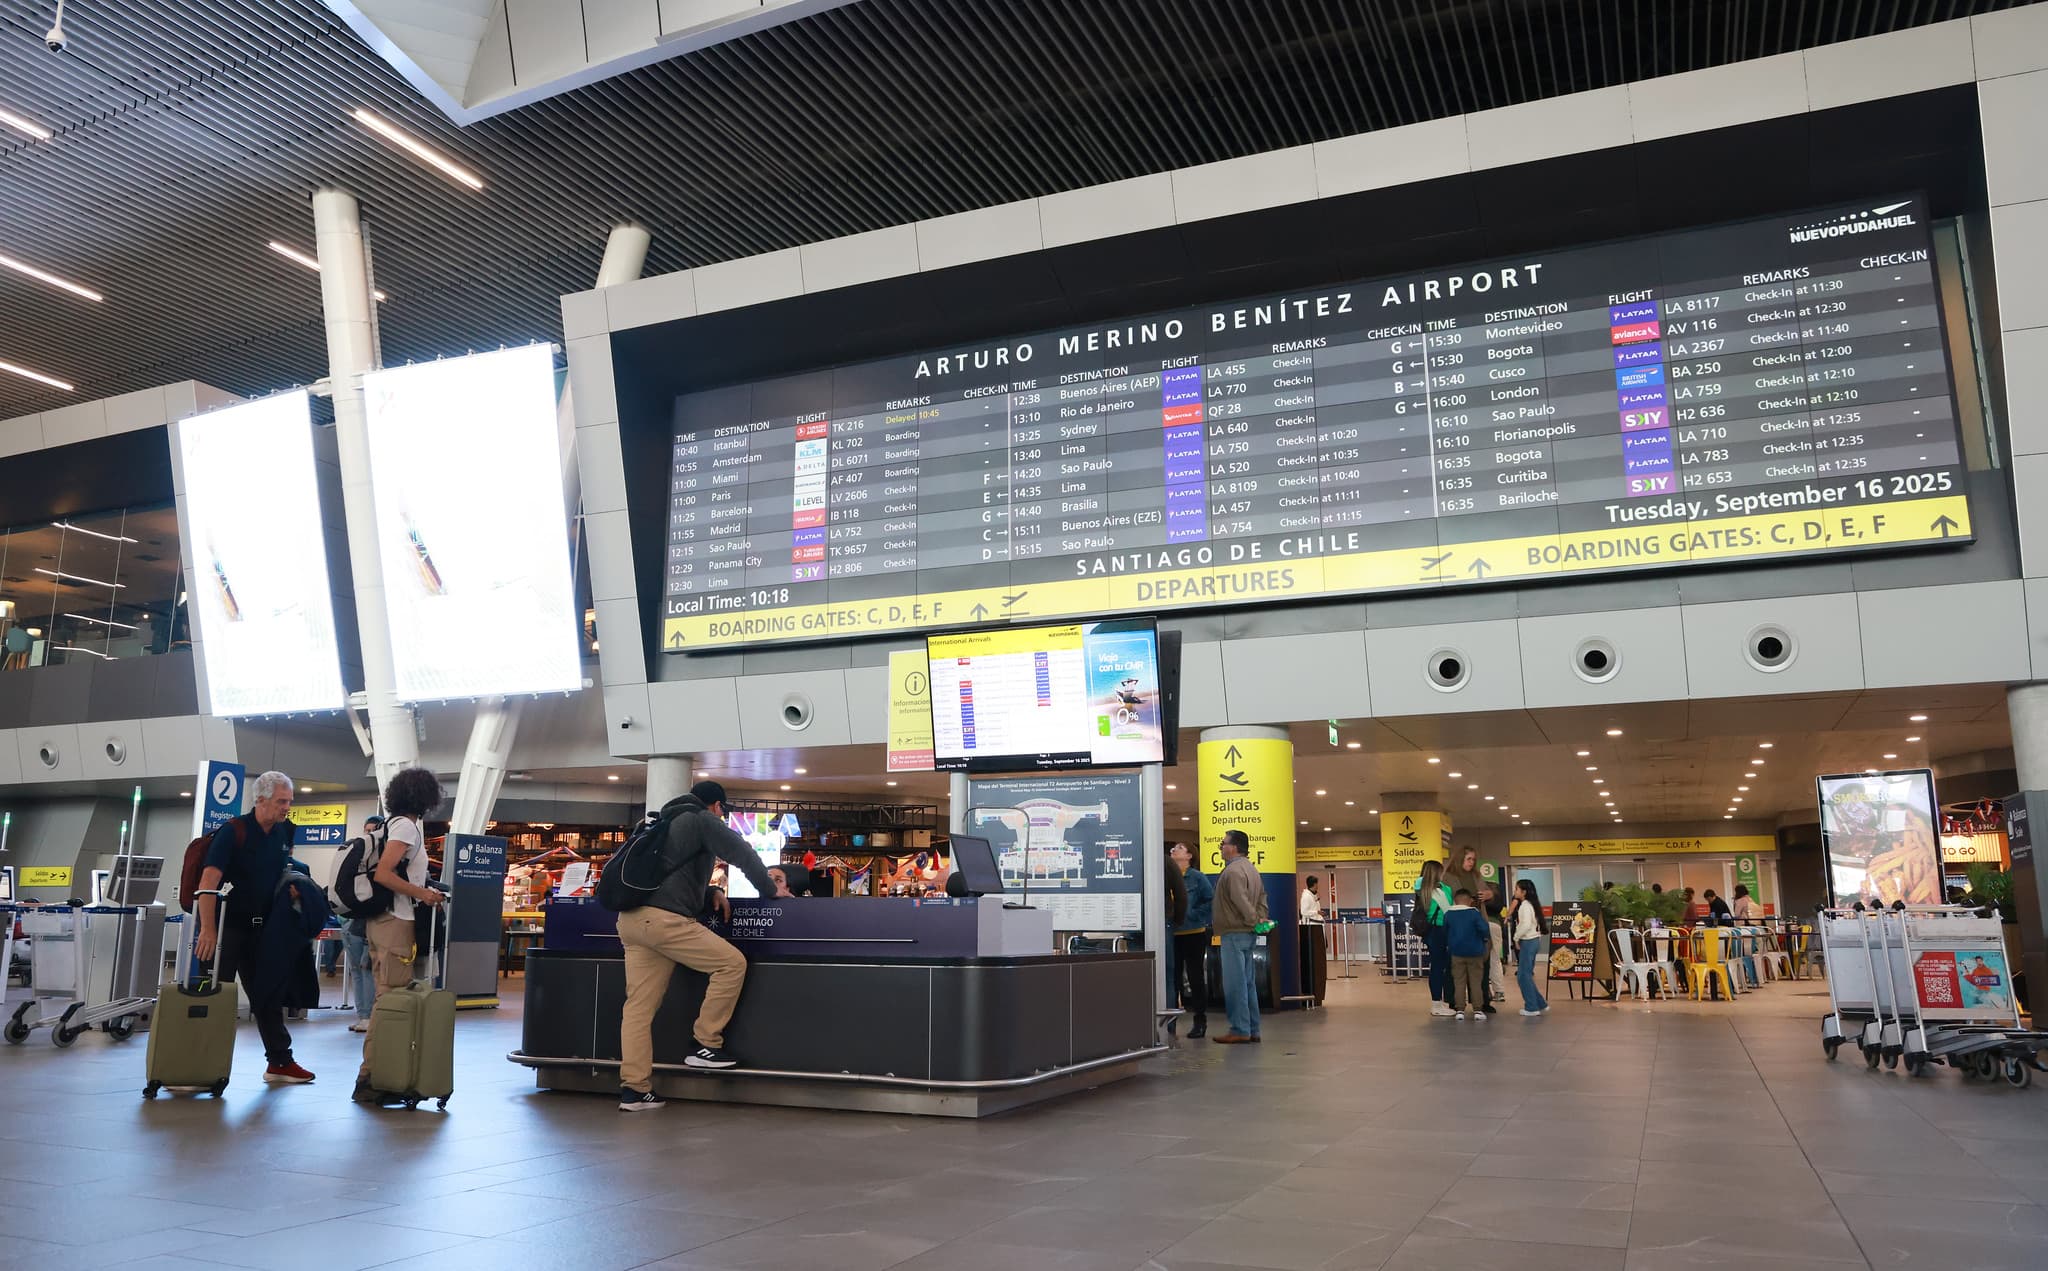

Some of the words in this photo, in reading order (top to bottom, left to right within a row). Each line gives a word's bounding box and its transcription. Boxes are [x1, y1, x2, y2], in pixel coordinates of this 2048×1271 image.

[1790, 213, 1916, 244] NUEVOPUDAHUEL
[1860, 249, 1928, 270] CHECK-IN
[1743, 266, 1810, 286] REMARKS
[1608, 289, 1653, 306] FLIGHT
[1745, 289, 1793, 302] Check-In
[1796, 284, 1808, 295] at
[1811, 280, 1844, 294] 11:30
[1484, 302, 1568, 323] DESTINATION
[1621, 308, 1654, 318] LATAM
[1665, 302, 1683, 315] LA
[1687, 297, 1720, 312] 8117
[915, 343, 1034, 379] ARTURO
[1058, 318, 1186, 356] MERINO
[1210, 287, 1355, 333] BENÍTEZ
[1382, 262, 1545, 308] AIRPORT
[1426, 318, 1457, 332] TIME
[1667, 322, 1687, 335] AV
[1692, 318, 1718, 333] 116
[1367, 323, 1422, 340] CHECK-IN
[1486, 320, 1563, 340] Montevideo
[1613, 327, 1647, 339] avianca
[1272, 337, 1327, 353] REMARKS
[1391, 341, 1402, 354] G
[1429, 334, 1462, 348] 15:30
[1488, 345, 1534, 361] Bogota
[1162, 355, 1199, 370] FLIGHT
[1272, 356, 1312, 369] Check-In
[1060, 366, 1129, 385] DESTINATION
[1171, 373, 1198, 382] LATAM
[1207, 367, 1222, 378] LA
[1225, 364, 1246, 376] 455
[1489, 367, 1526, 380] Cusco
[964, 384, 1008, 399] CHECK-IN
[1013, 379, 1037, 392] TIME
[1060, 387, 1098, 400] Buenos
[1100, 384, 1127, 396] Aires
[1130, 376, 1161, 392] (AEP)
[1013, 394, 1041, 406] 12:38
[1491, 386, 1540, 401] London
[886, 396, 931, 411] REMARKS
[1061, 406, 1077, 418] Rio
[1080, 404, 1093, 415] de
[1096, 400, 1135, 414] Janeiro
[796, 412, 827, 424] FLIGHT
[885, 412, 916, 425] Delayed
[919, 409, 940, 419] 10:45
[714, 421, 770, 438] DESTINATION
[832, 423, 846, 433] TK
[847, 420, 864, 431] 216
[1060, 423, 1098, 438] Sydney
[1494, 423, 1576, 442] Florianopolis
[676, 433, 696, 443] TIME
[885, 430, 920, 442] Boarding
[675, 446, 698, 457] 10:40
[713, 438, 747, 451] Istanbul
[712, 454, 762, 468] Amsterdam
[712, 472, 739, 484] Miami
[983, 473, 991, 485] F
[1497, 470, 1548, 485] Curitiba
[711, 490, 731, 502] Paris
[831, 493, 844, 503] LV
[845, 490, 868, 501] 2606
[884, 485, 917, 497] Check-In
[1499, 490, 1559, 506] Bariloche
[1605, 498, 1709, 523] Tuesday,
[1715, 482, 1848, 514] September
[1854, 478, 1883, 499] 16
[1887, 472, 1952, 495] 2025
[802, 493, 824, 506] LEVEL
[1061, 499, 1098, 513] Brasilia
[711, 505, 753, 519] Barcelona
[710, 523, 741, 536] Madrid
[709, 544, 726, 553] Sao
[727, 540, 752, 551] Paulo
[1527, 536, 1660, 566] BOARDING
[1669, 526, 1761, 552] GATES:
[1770, 523, 1794, 545] C,
[1803, 521, 1831, 542] D,
[1840, 518, 1864, 539] E,
[1873, 514, 1887, 535] F
[1076, 547, 1213, 576] SANTIAGO
[1230, 542, 1262, 561] DE
[1279, 533, 1360, 556] CHILE
[708, 559, 743, 570] Panama
[745, 556, 762, 567] City
[708, 577, 729, 588] Lima
[1137, 568, 1295, 602] DEPARTURES
[668, 596, 703, 614] Local
[707, 595, 746, 610] Time:
[750, 588, 789, 605] 10:18
[709, 616, 796, 638] BOARDING
[802, 609, 861, 630] GATES:
[867, 608, 882, 625] C,
[889, 606, 906, 624] D,
[912, 604, 928, 621] E,
[934, 602, 943, 618] F
[218, 776, 231, 800] 2
[1213, 798, 1260, 812] Salidas
[1212, 816, 1262, 826] Departures
[475, 843, 503, 855] Balanza
[1394, 848, 1425, 857] Salidas
[1959, 847, 1976, 856] GO
[474, 856, 491, 865] Scale
[1743, 860, 1750, 871] 3
[1483, 864, 1491, 876] 3
[732, 907, 783, 917] AEROPUERTO
[732, 918, 774, 927] SANTIAGO
[732, 928, 743, 937] DE
[743, 928, 765, 937] CHILE
